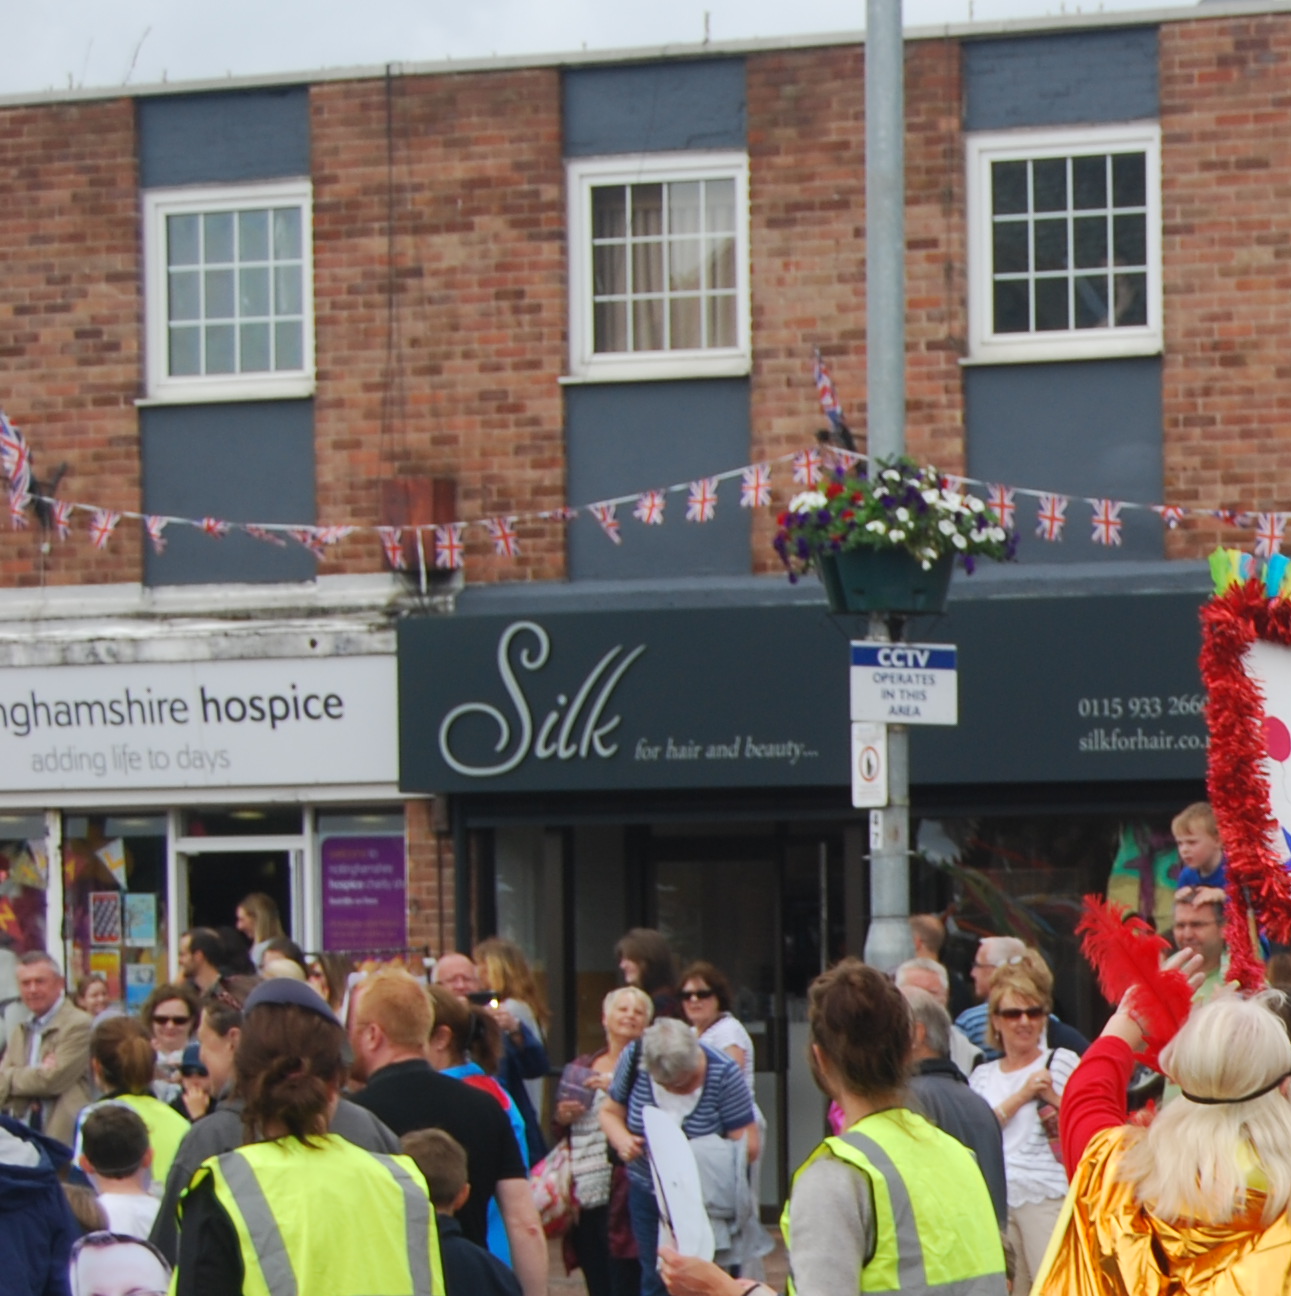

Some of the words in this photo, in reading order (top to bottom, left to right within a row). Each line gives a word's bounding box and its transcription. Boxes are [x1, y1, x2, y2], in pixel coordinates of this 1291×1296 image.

[877, 647, 930, 669] CCTV
[872, 671, 936, 686] OPERATES
[439, 620, 647, 777] Silk
[881, 688, 896, 701] IN
[899, 688, 928, 701] THIS
[200, 683, 344, 730] hospice
[887, 704, 922, 718] AREA
[1078, 697, 1123, 719] 0115
[1128, 697, 1162, 718] 933
[634, 738, 661, 761] for
[665, 738, 702, 760] hair
[705, 737, 741, 759] and
[31, 746, 107, 777] adding
[112, 744, 142, 775] life
[148, 747, 170, 771] to
[177, 744, 232, 774] days
